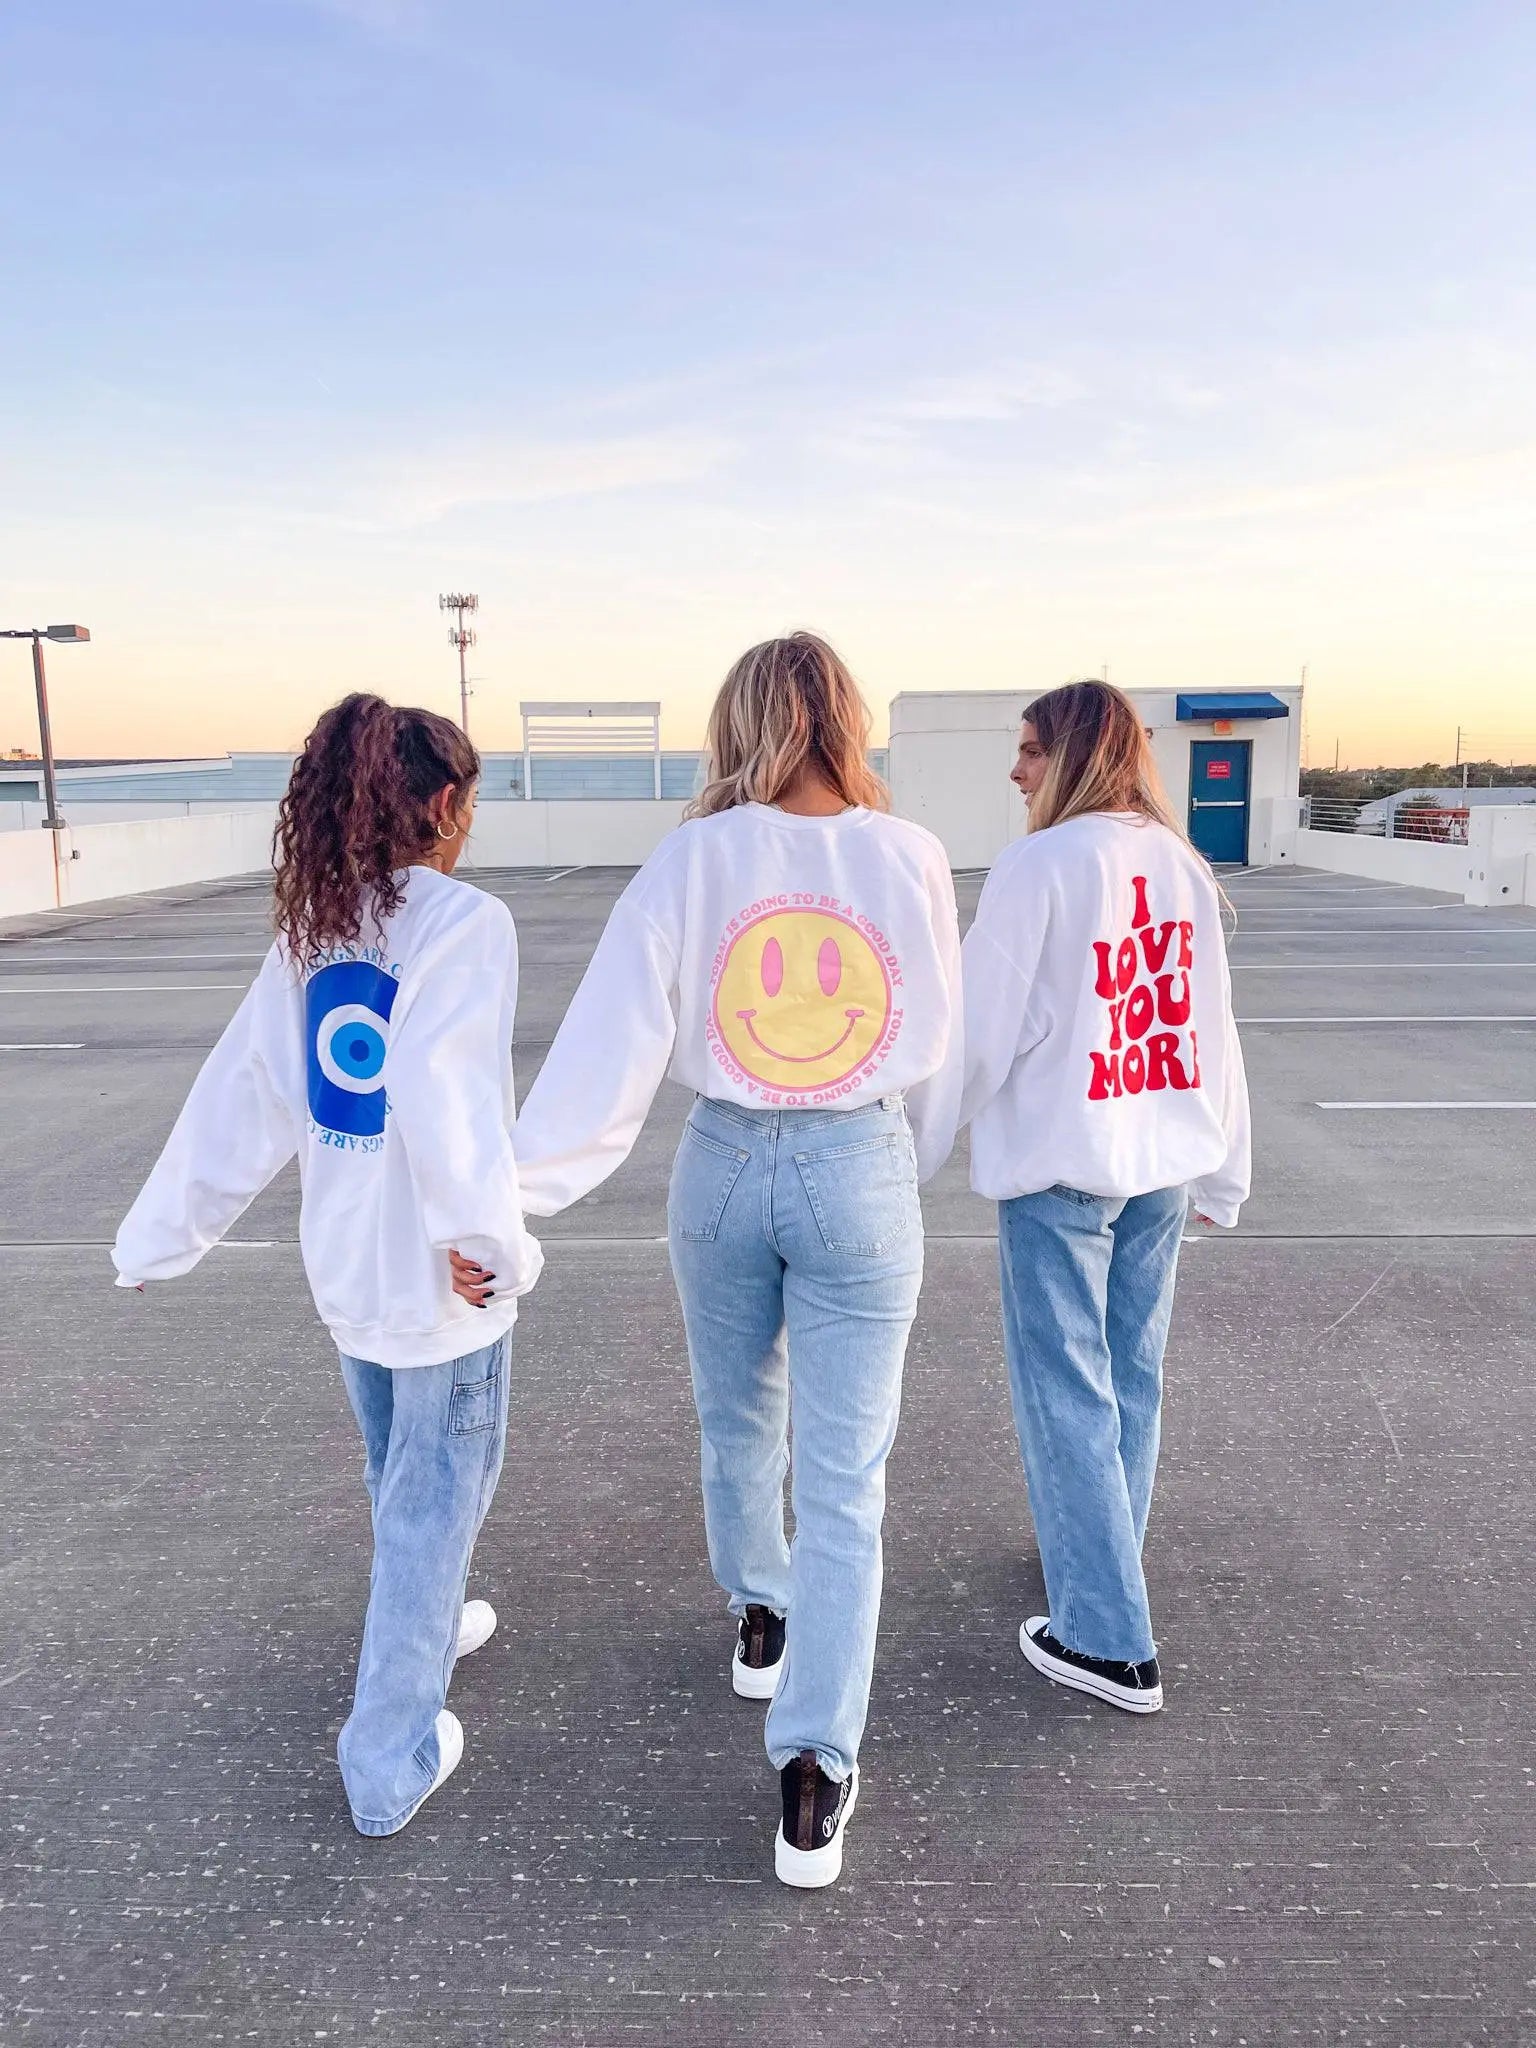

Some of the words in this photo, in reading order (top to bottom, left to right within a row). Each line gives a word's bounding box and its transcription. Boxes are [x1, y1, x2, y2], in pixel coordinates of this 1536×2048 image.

[1132, 876, 1150, 929] I
[726, 917, 740, 935] IS
[739, 894, 789, 921] GOING
[791, 892, 815, 905] TO
[818, 895, 841, 910] BE
[842, 905, 854, 917] A
[856, 914, 891, 953] GOOD
[885, 955, 904, 987] DAY
[1109, 970, 1190, 1051] YOU
[877, 1008, 904, 1063] TODAY
[711, 1043, 744, 1085] GOOD
[862, 1061, 879, 1078] IS
[747, 1081, 759, 1095] A
[760, 1089, 782, 1105] BE
[785, 1095, 808, 1106] TO
[813, 1075, 862, 1105] GOING
[318, 1129, 359, 1152] ARE
